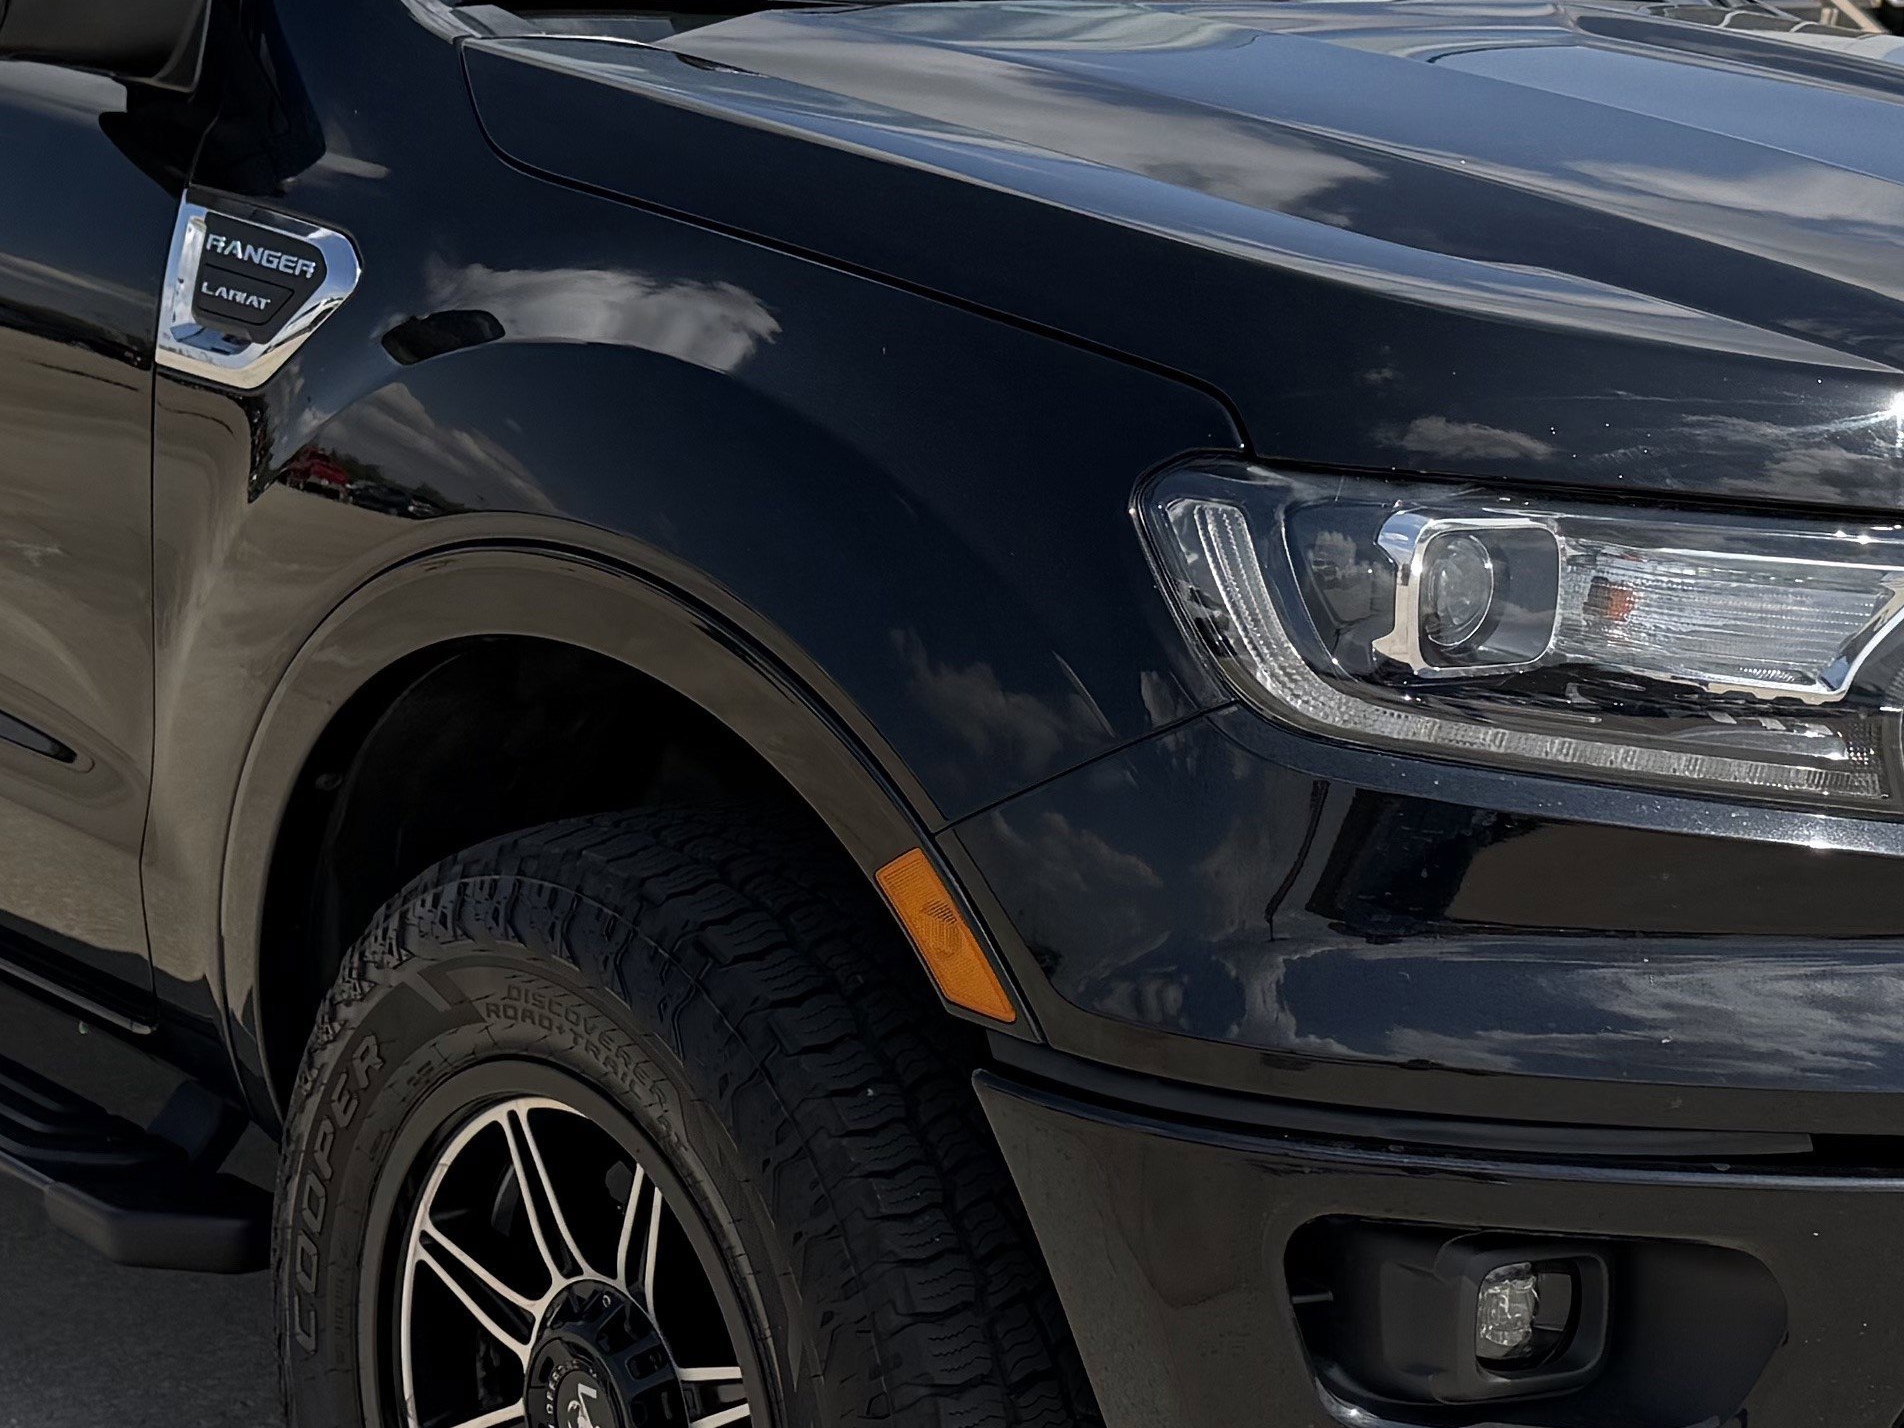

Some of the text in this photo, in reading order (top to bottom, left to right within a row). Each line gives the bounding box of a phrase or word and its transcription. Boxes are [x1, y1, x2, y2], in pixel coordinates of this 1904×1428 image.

[207, 233, 317, 280] RANGER
[201, 281, 271, 311] LARIAT
[295, 1034, 386, 1358] COOPER
